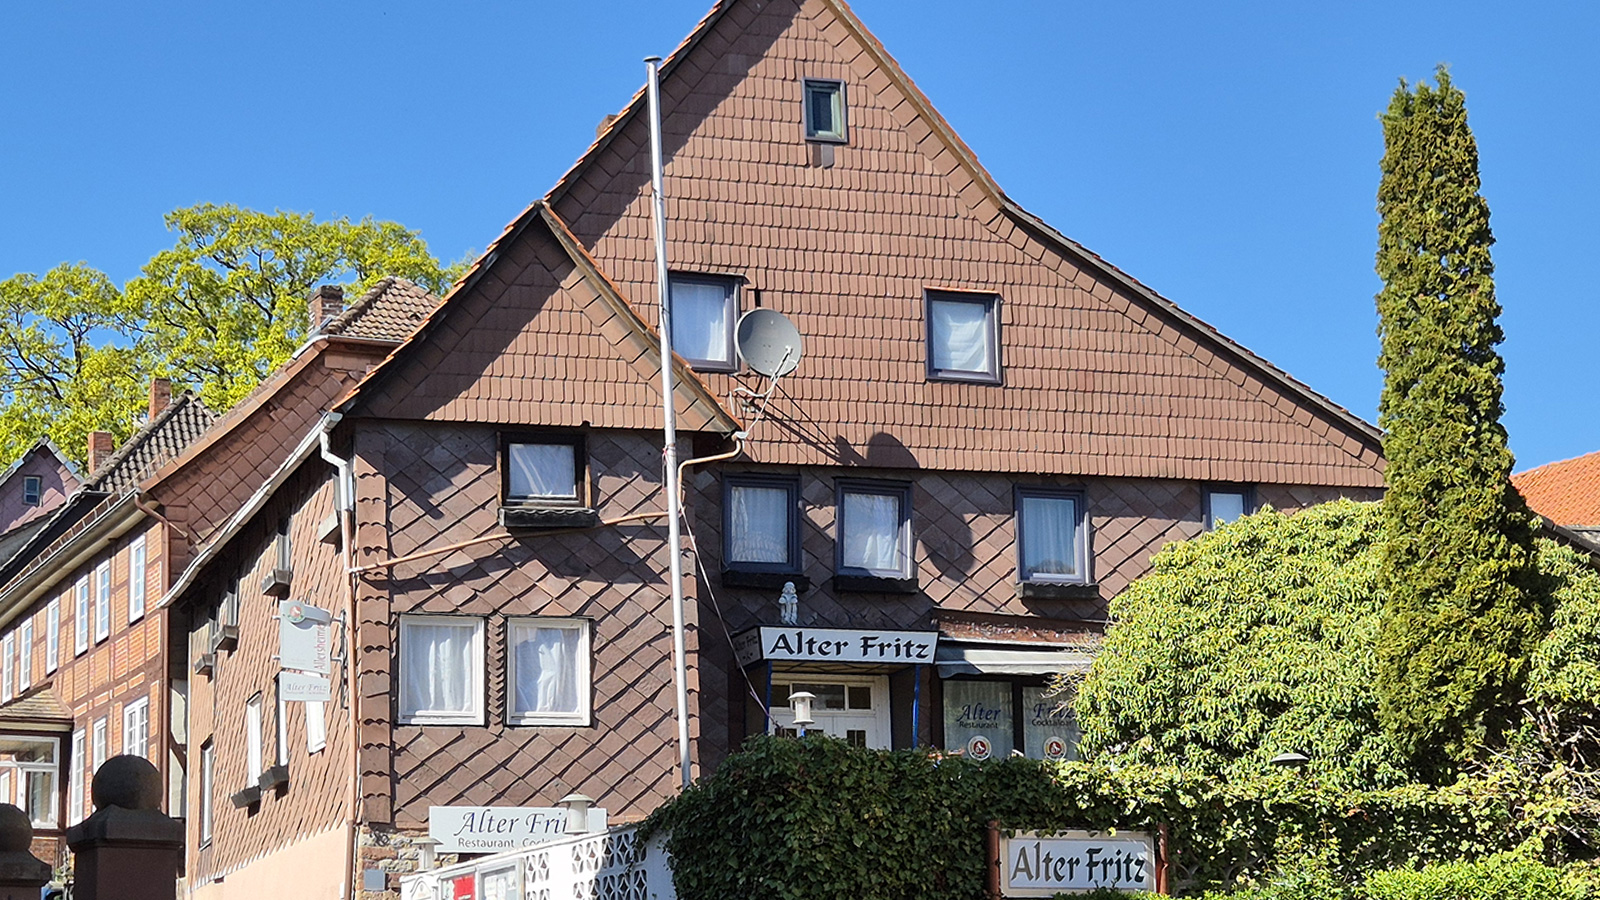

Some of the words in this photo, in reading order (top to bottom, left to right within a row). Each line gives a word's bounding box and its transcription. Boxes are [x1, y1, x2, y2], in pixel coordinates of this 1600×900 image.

[314, 622, 327, 669] Allersheime
[768, 631, 848, 656] Alter
[859, 636, 930, 658] Fritz
[285, 682, 305, 691] Alter
[308, 683, 327, 692] Fritz
[957, 702, 1001, 722] Alter
[959, 721, 998, 729] Restaurant
[453, 809, 519, 836] Alter
[525, 812, 567, 834] Frit
[458, 838, 514, 848] Restaurant
[1011, 841, 1080, 882] Alter
[1086, 847, 1145, 883] Fritz
